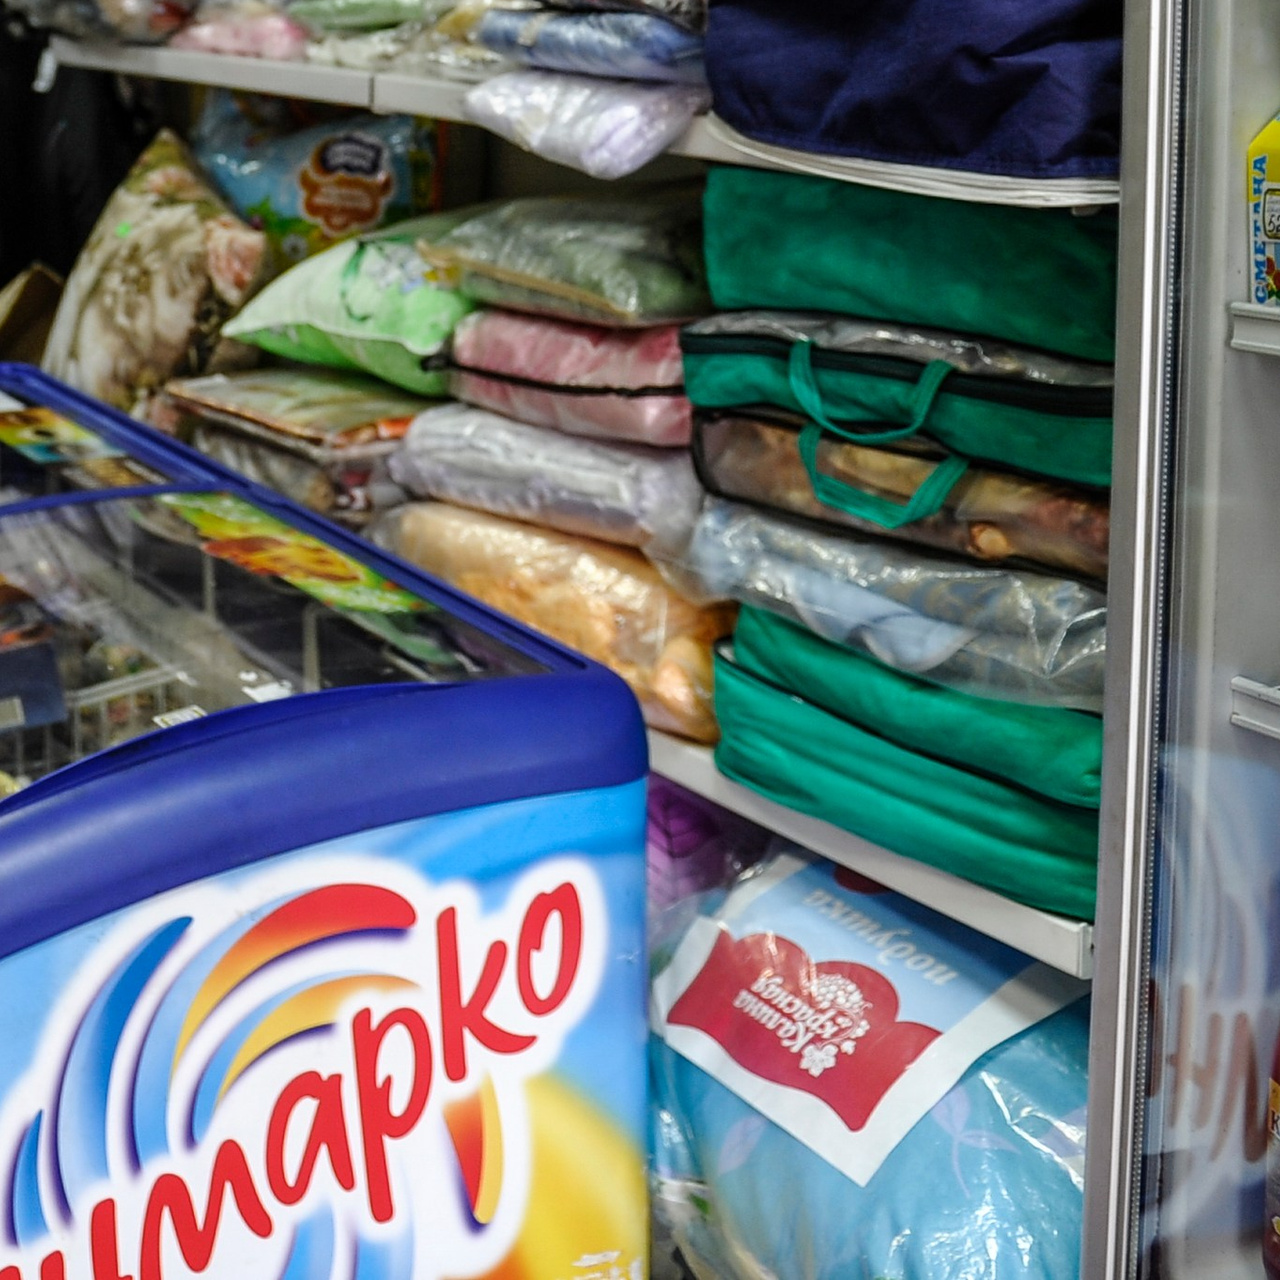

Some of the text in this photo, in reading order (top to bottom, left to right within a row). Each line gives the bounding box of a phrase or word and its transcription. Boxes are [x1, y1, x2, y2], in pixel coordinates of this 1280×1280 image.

[803, 889, 958, 986] подушка
[732, 988, 815, 1053] Калина
[750, 974, 839, 1039] красная
